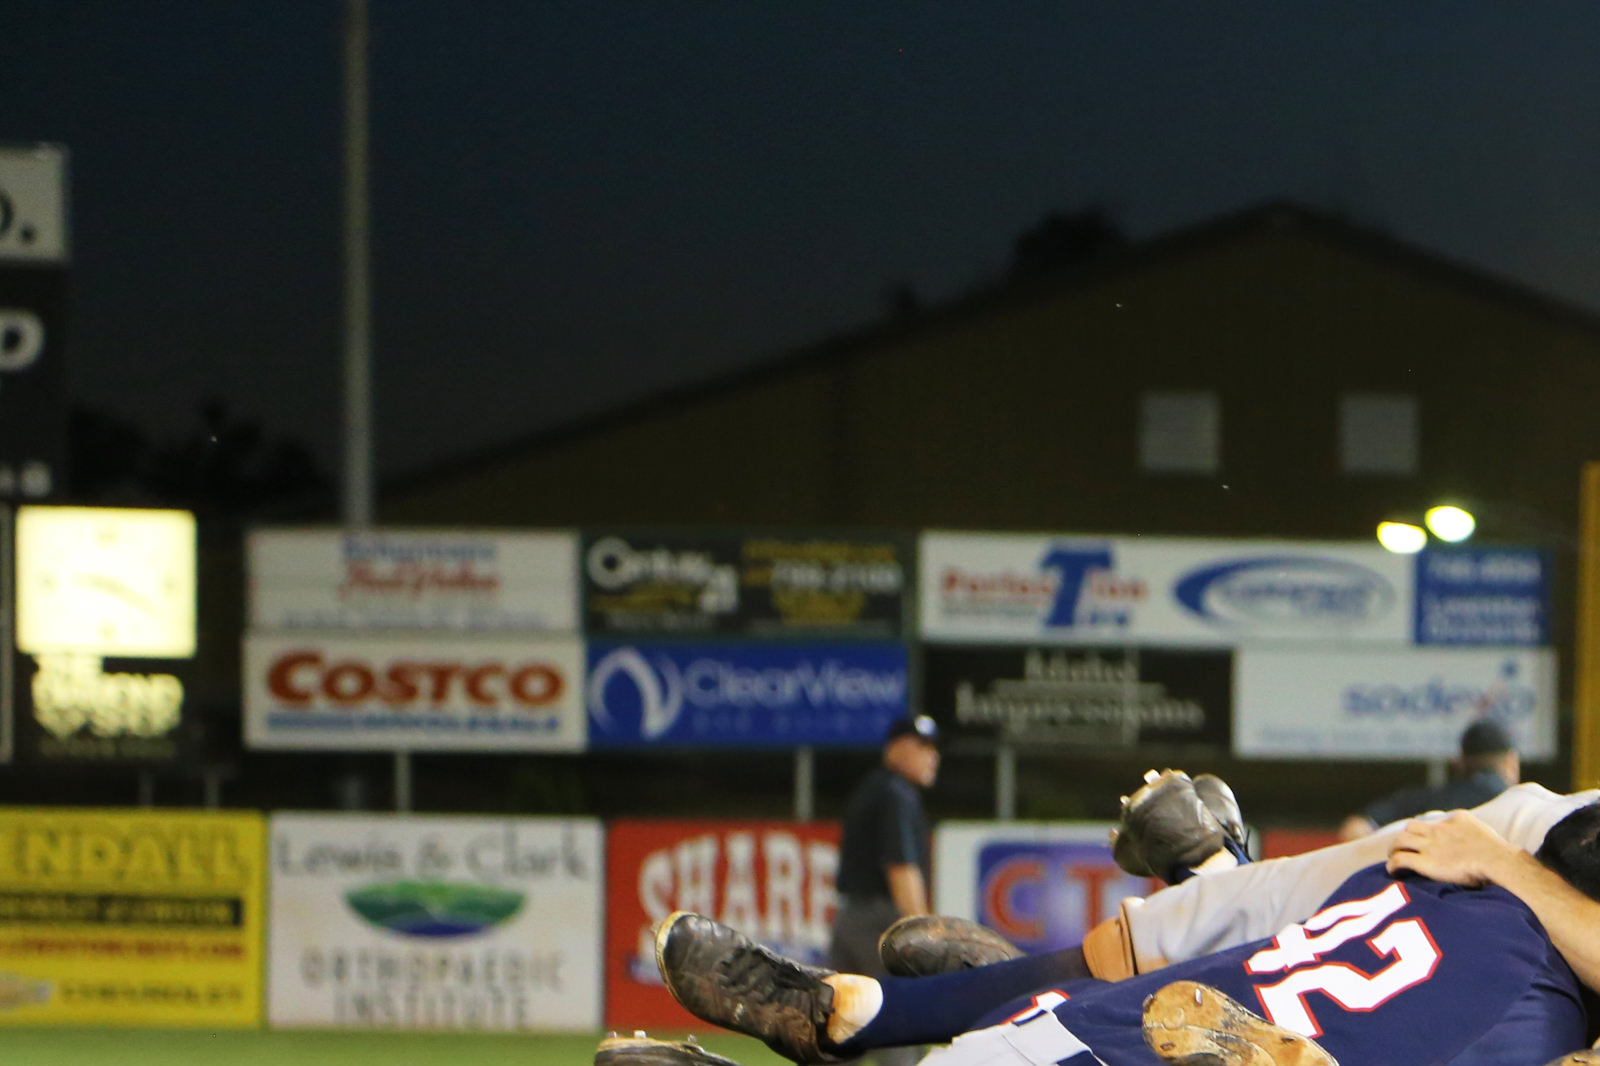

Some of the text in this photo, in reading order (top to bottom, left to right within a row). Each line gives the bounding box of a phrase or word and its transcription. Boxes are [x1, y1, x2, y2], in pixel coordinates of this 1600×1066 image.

[684, 656, 906, 706] ClearView
[0, 826, 246, 884] NDALL
[275, 823, 590, 880] Lewis & Clark
[1243, 880, 1443, 1040] 42
